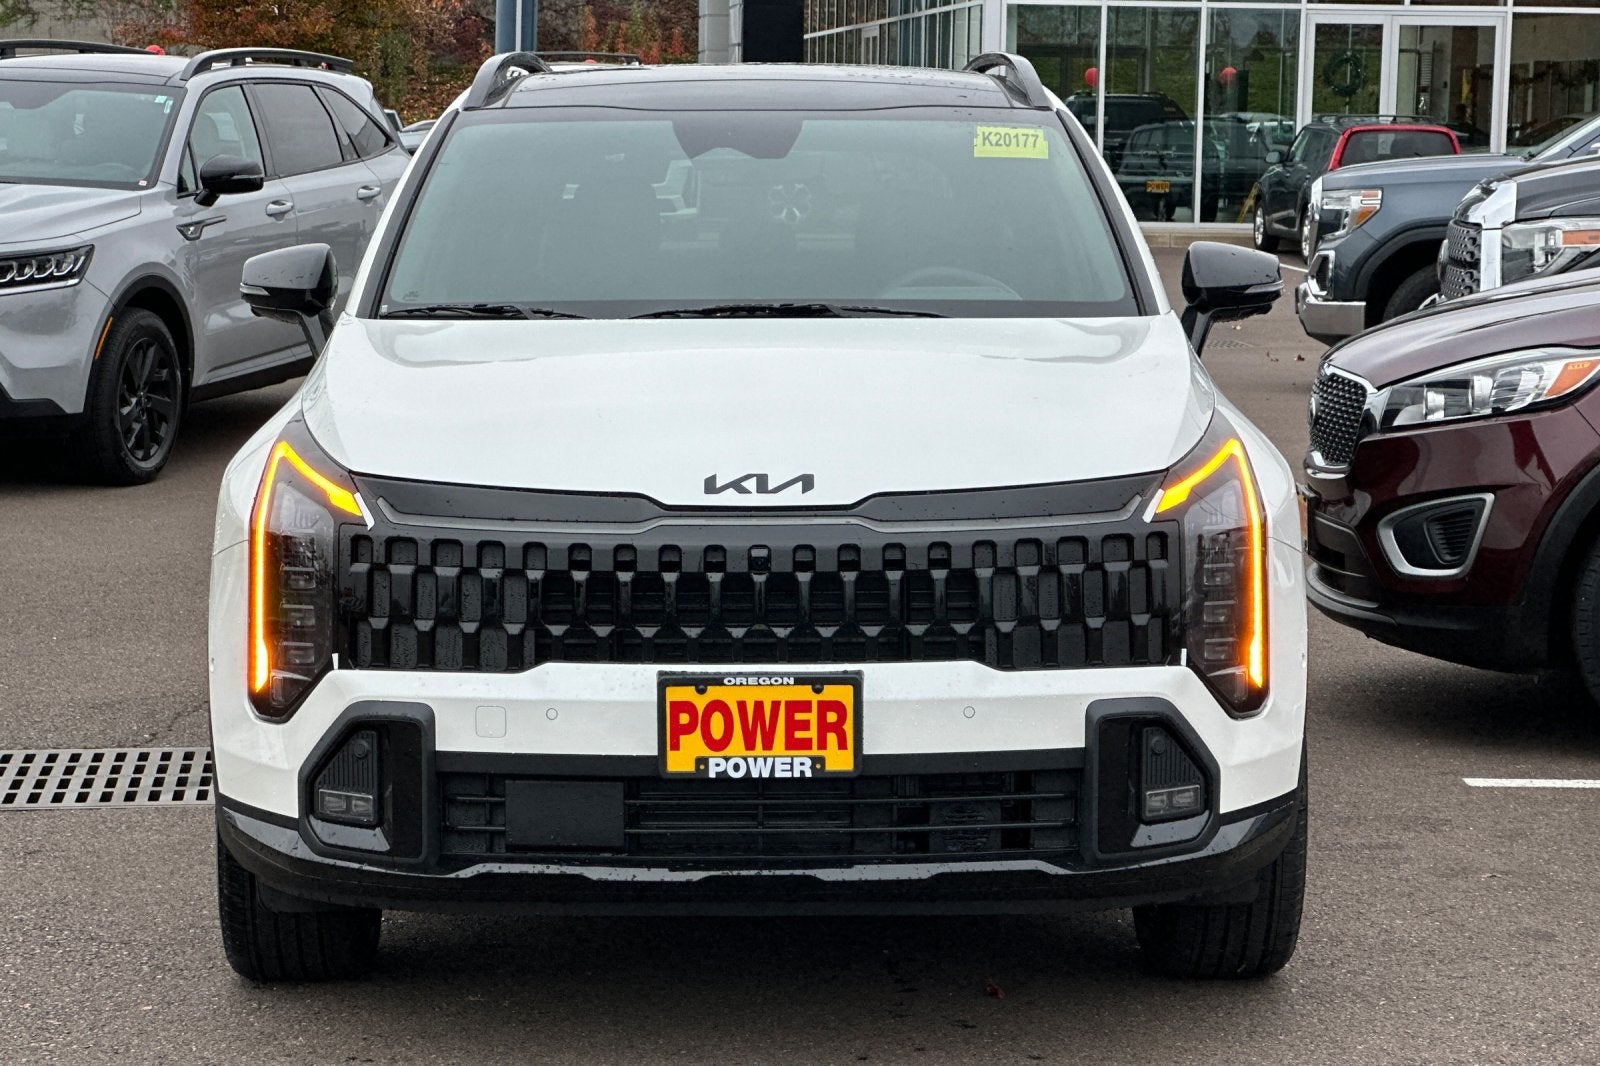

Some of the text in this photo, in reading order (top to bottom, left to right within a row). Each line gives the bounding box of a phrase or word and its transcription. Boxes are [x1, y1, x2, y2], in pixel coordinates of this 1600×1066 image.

[981, 131, 1039, 148] K20177
[704, 473, 814, 494] KIA
[723, 677, 795, 685] OREGON
[669, 699, 848, 752] POWER
[708, 757, 812, 778] POWER
